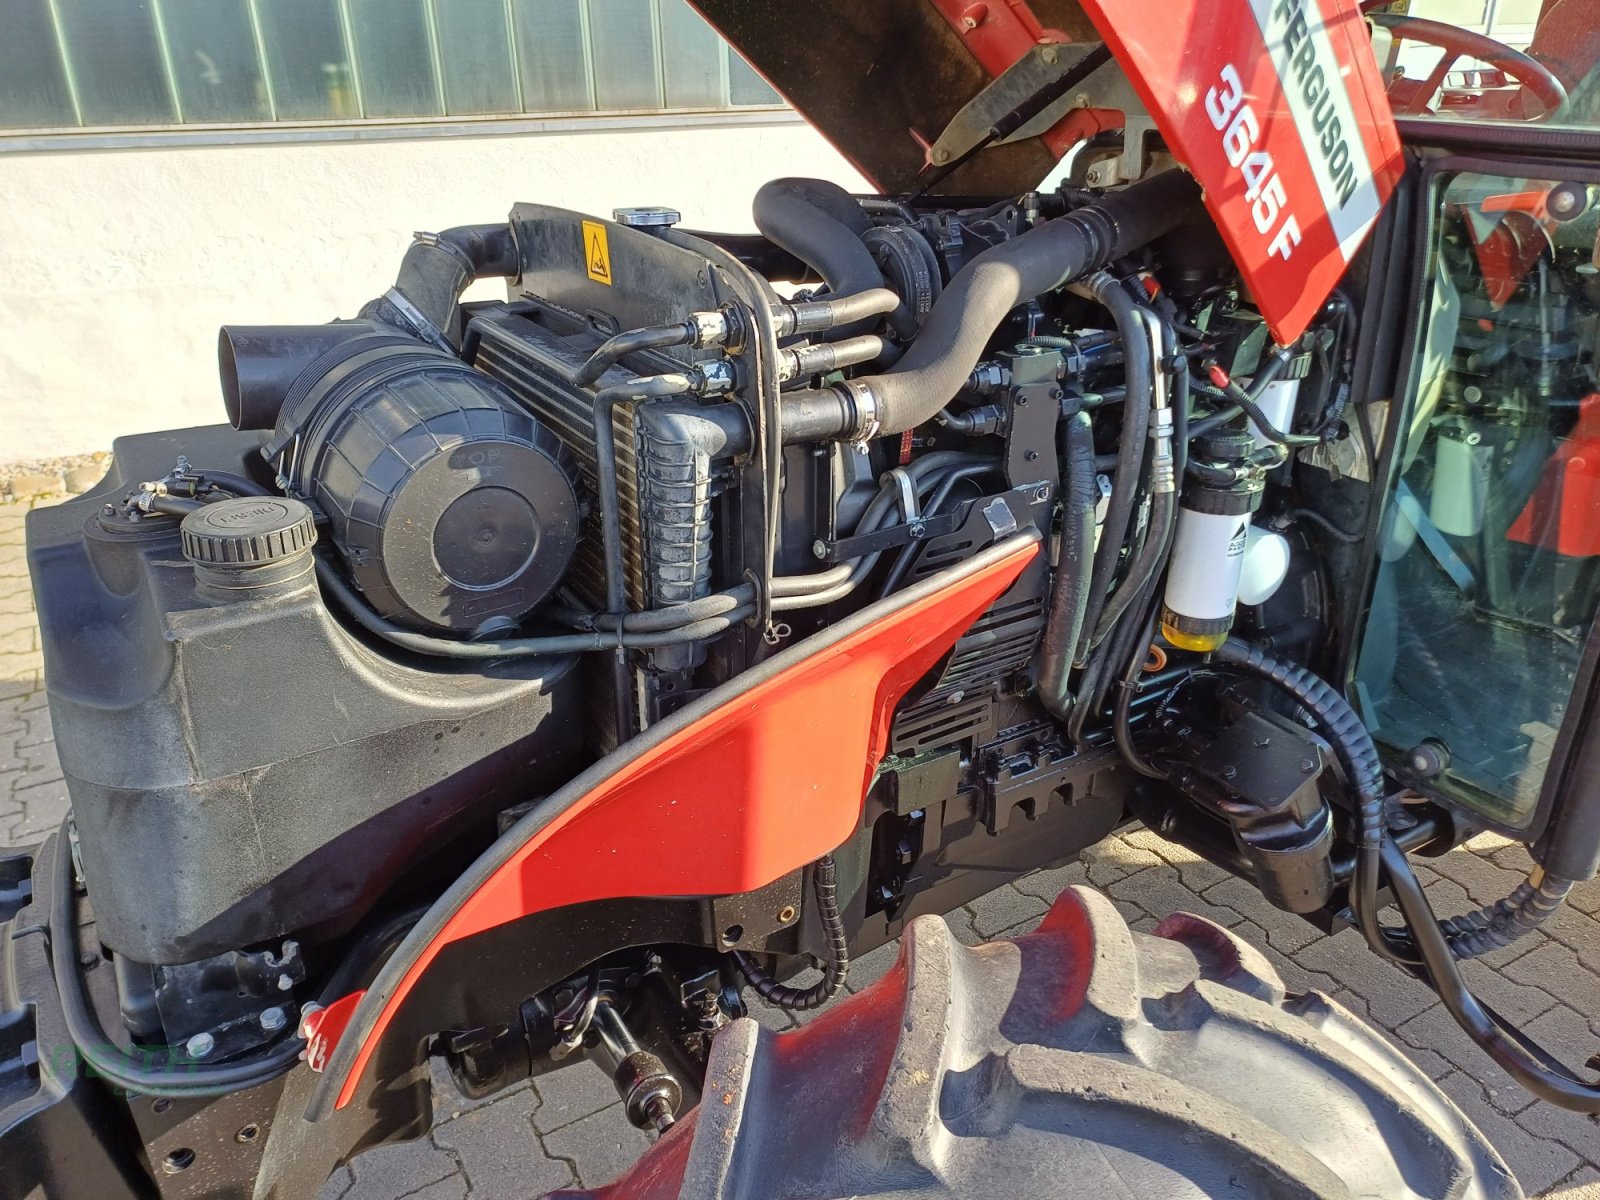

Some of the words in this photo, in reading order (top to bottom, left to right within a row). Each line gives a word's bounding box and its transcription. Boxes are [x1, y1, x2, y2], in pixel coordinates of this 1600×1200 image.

[1204, 63, 1288, 235] 3645
[1267, 212, 1302, 261] F
[1274, 0, 1358, 210] FERGUSON
